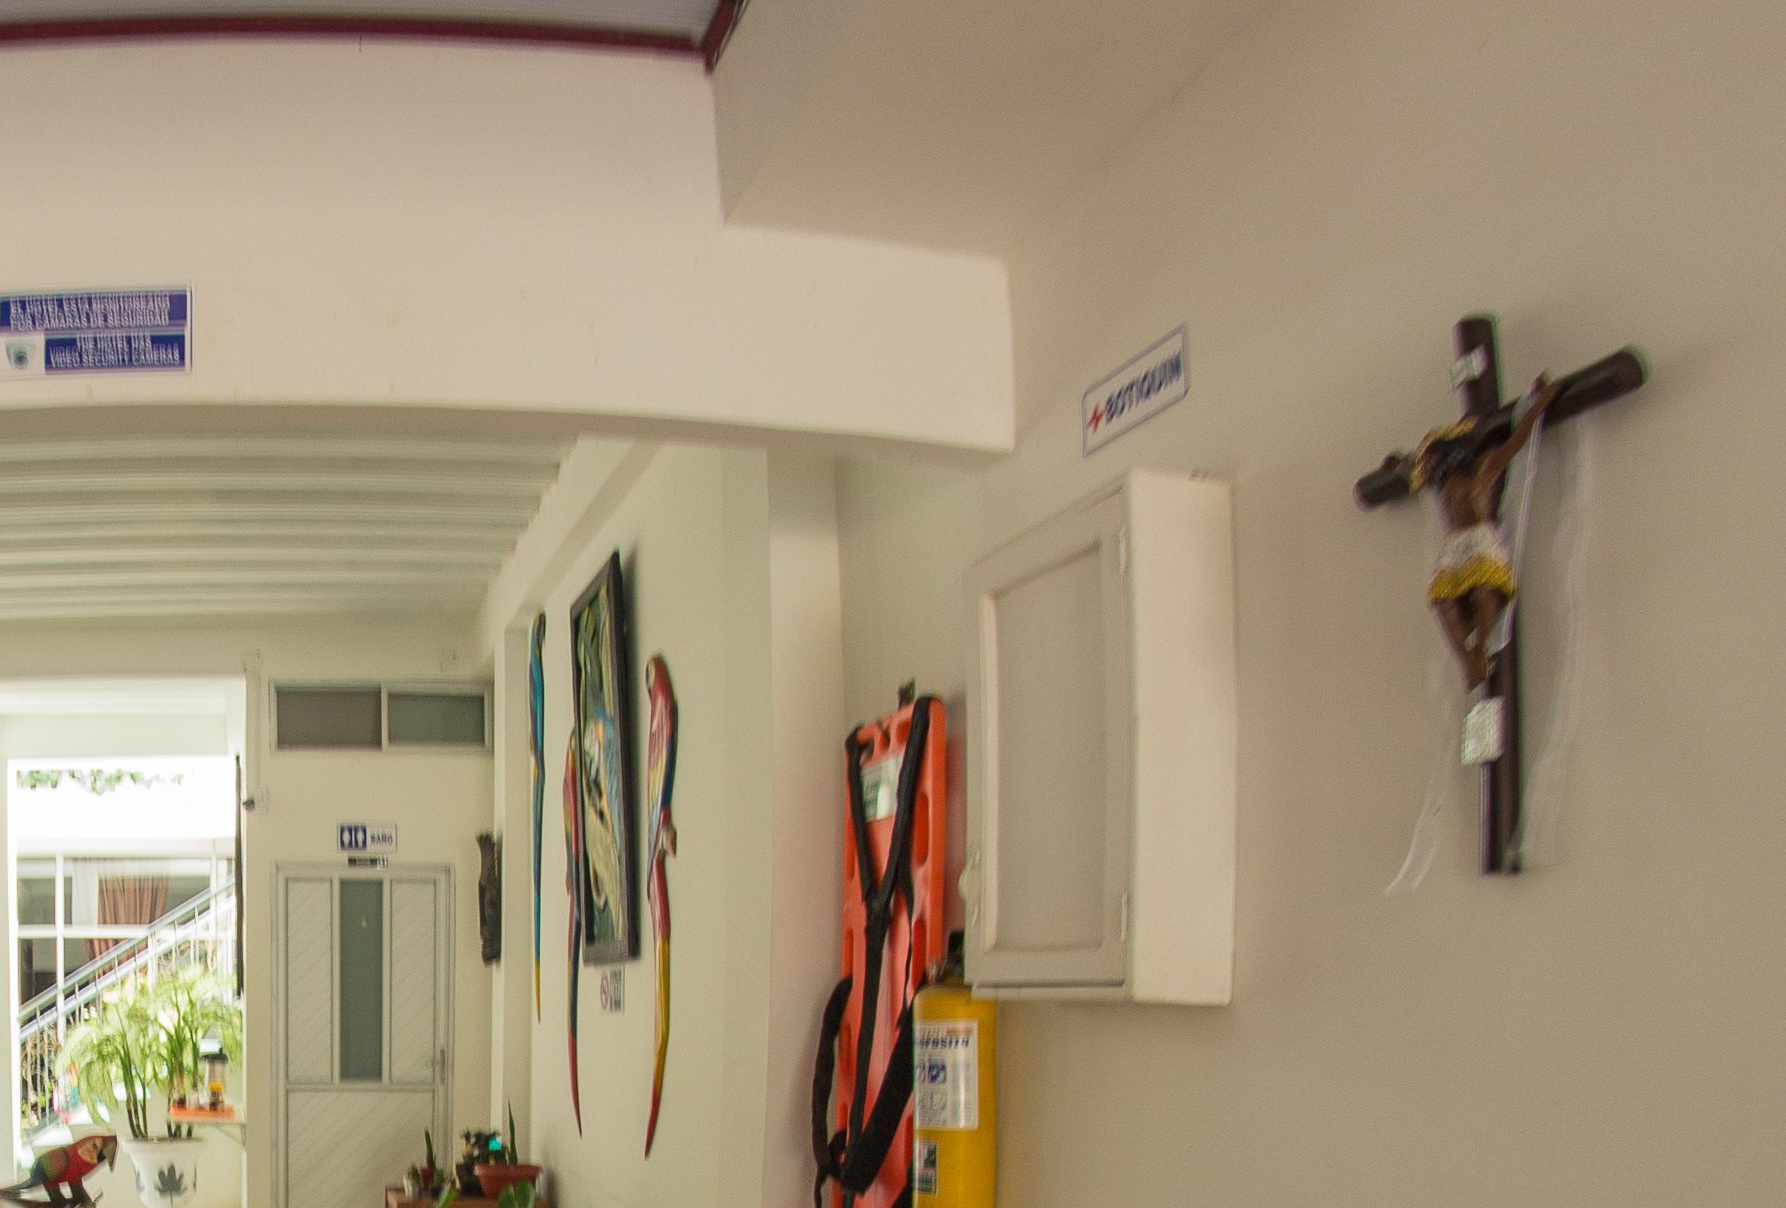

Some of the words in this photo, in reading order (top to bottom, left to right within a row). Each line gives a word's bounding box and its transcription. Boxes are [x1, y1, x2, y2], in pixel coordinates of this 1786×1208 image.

[50, 350, 80, 368] VIDEO
[82, 349, 129, 368] SECURITY
[132, 347, 180, 366] CAMERAS
